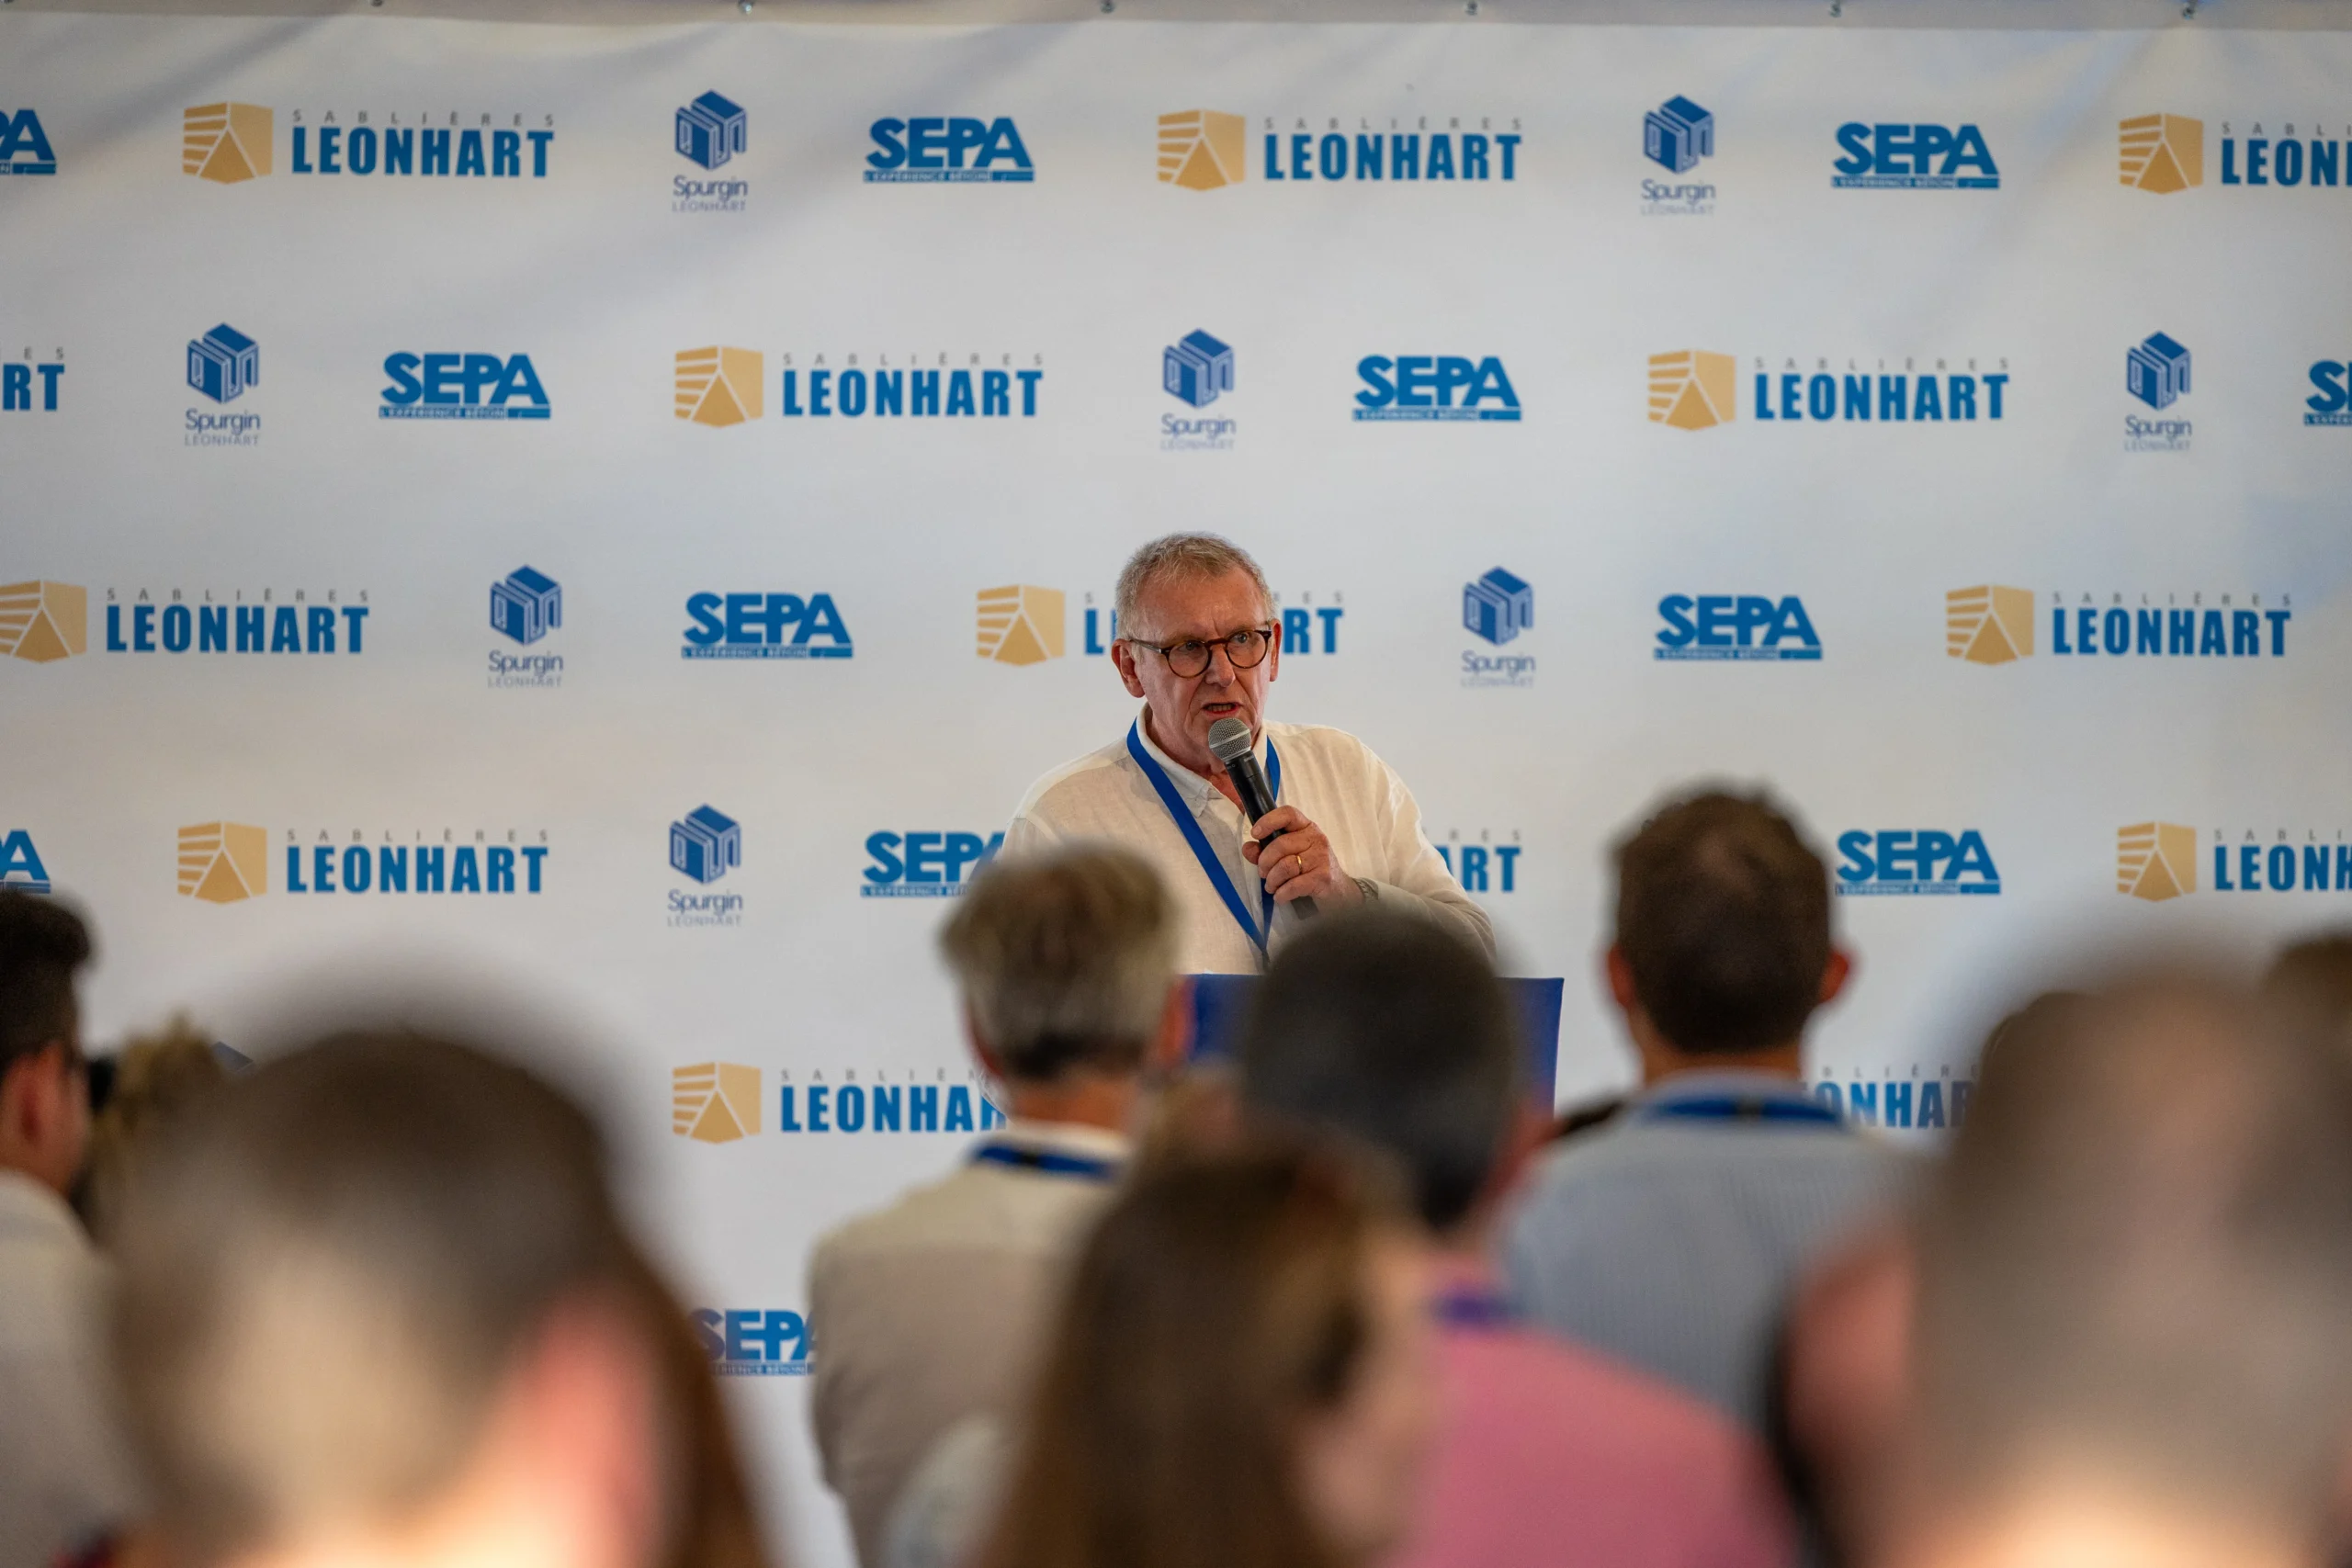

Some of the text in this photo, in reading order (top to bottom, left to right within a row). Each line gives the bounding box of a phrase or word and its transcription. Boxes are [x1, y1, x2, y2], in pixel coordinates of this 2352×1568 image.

[291, 127, 554, 176] LEONHART
[865, 117, 1034, 169] SEPA
[1833, 122, 1999, 175] SEPA
[2222, 122, 2352, 137] SABLI
[1264, 133, 1522, 181] LEONHART
[2222, 138, 2352, 186] LEON
[673, 175, 749, 201] Spurgin
[1642, 178, 1715, 205] Spurgin
[380, 352, 550, 404] SEPA
[783, 369, 1044, 417] LEONHART
[1354, 355, 1521, 407] SEPA
[1755, 373, 2009, 422] LEONHART
[186, 407, 261, 434] Spurgin
[1161, 413, 1236, 440] Spurgin
[2125, 414, 2192, 441] Spurgin
[107, 604, 369, 654] LEONHART
[684, 592, 853, 645] SEPA
[1656, 593, 1822, 646] SEPA
[2053, 607, 2292, 657] LEONHART
[488, 649, 564, 677] Spurgin
[1462, 649, 1536, 676] Spurgin
[1836, 830, 2000, 882] SEPA
[2215, 829, 2342, 841] SABLI
[287, 845, 548, 894] LEONHART
[2215, 844, 2352, 892] LEONH
[668, 889, 743, 917] Spurgin
[781, 1085, 1007, 1133] LEONHAR
